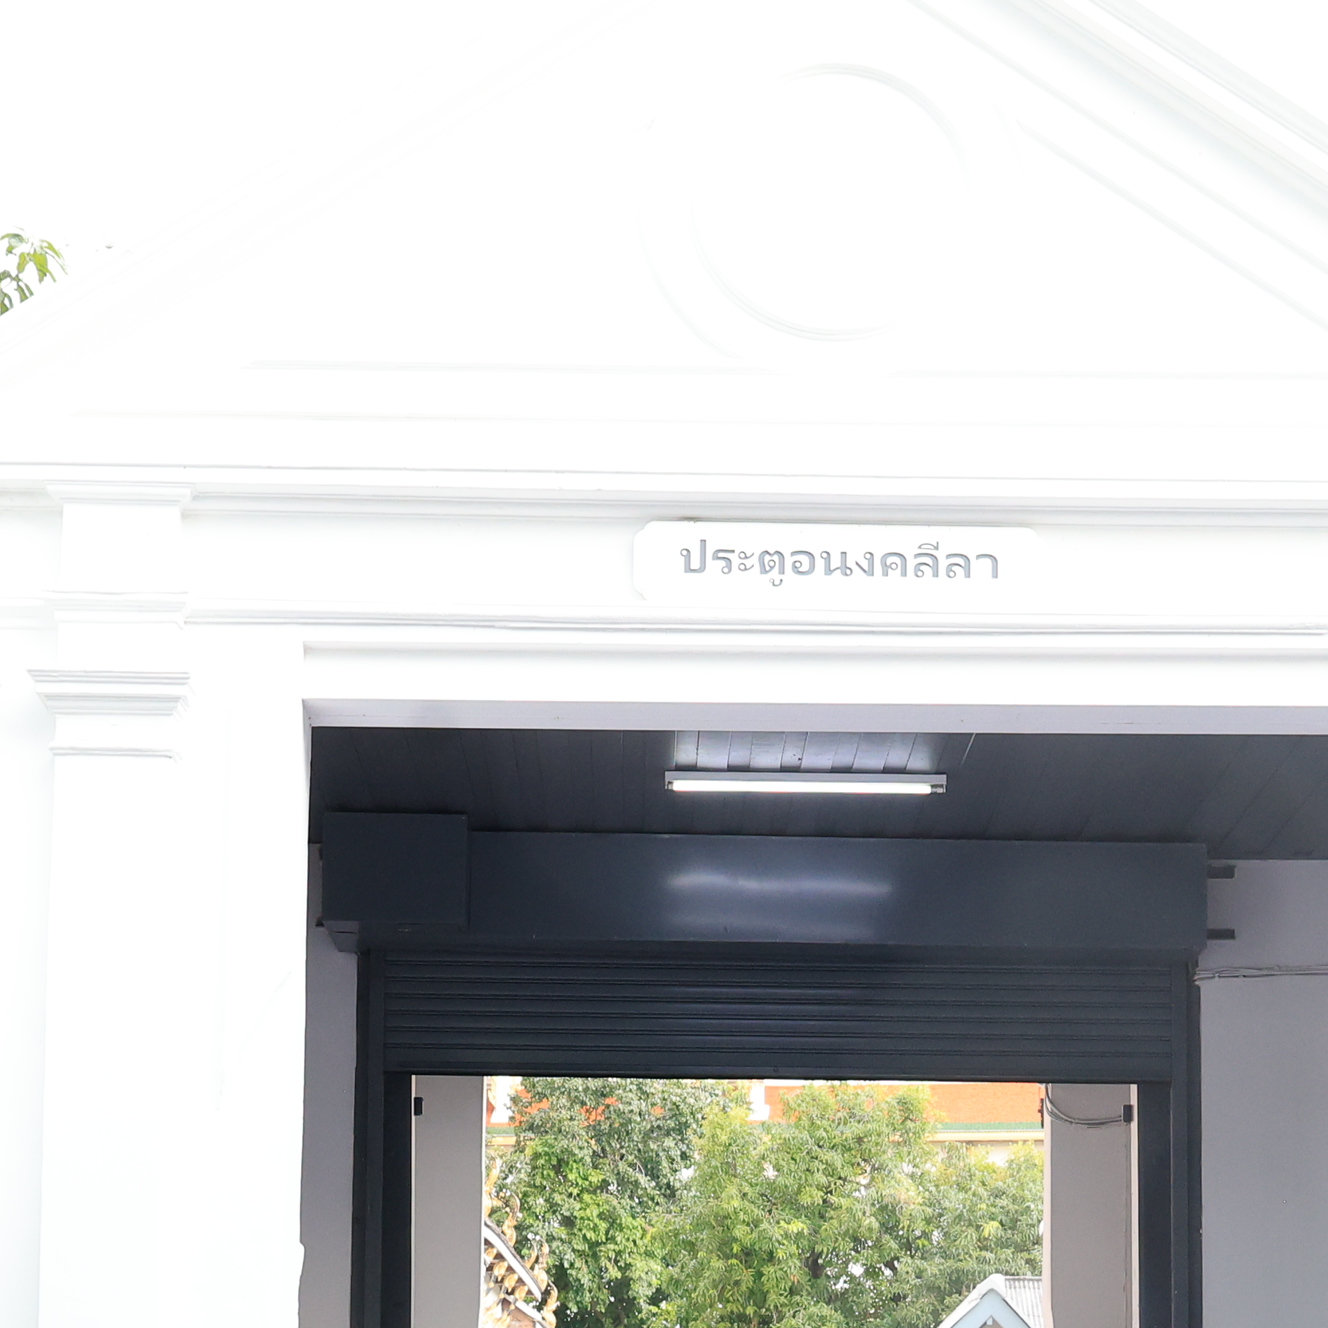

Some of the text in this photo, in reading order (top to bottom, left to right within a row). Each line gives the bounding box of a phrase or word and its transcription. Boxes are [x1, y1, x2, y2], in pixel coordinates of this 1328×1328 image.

[680, 539, 999, 587] ประตูอนงคลีลา
